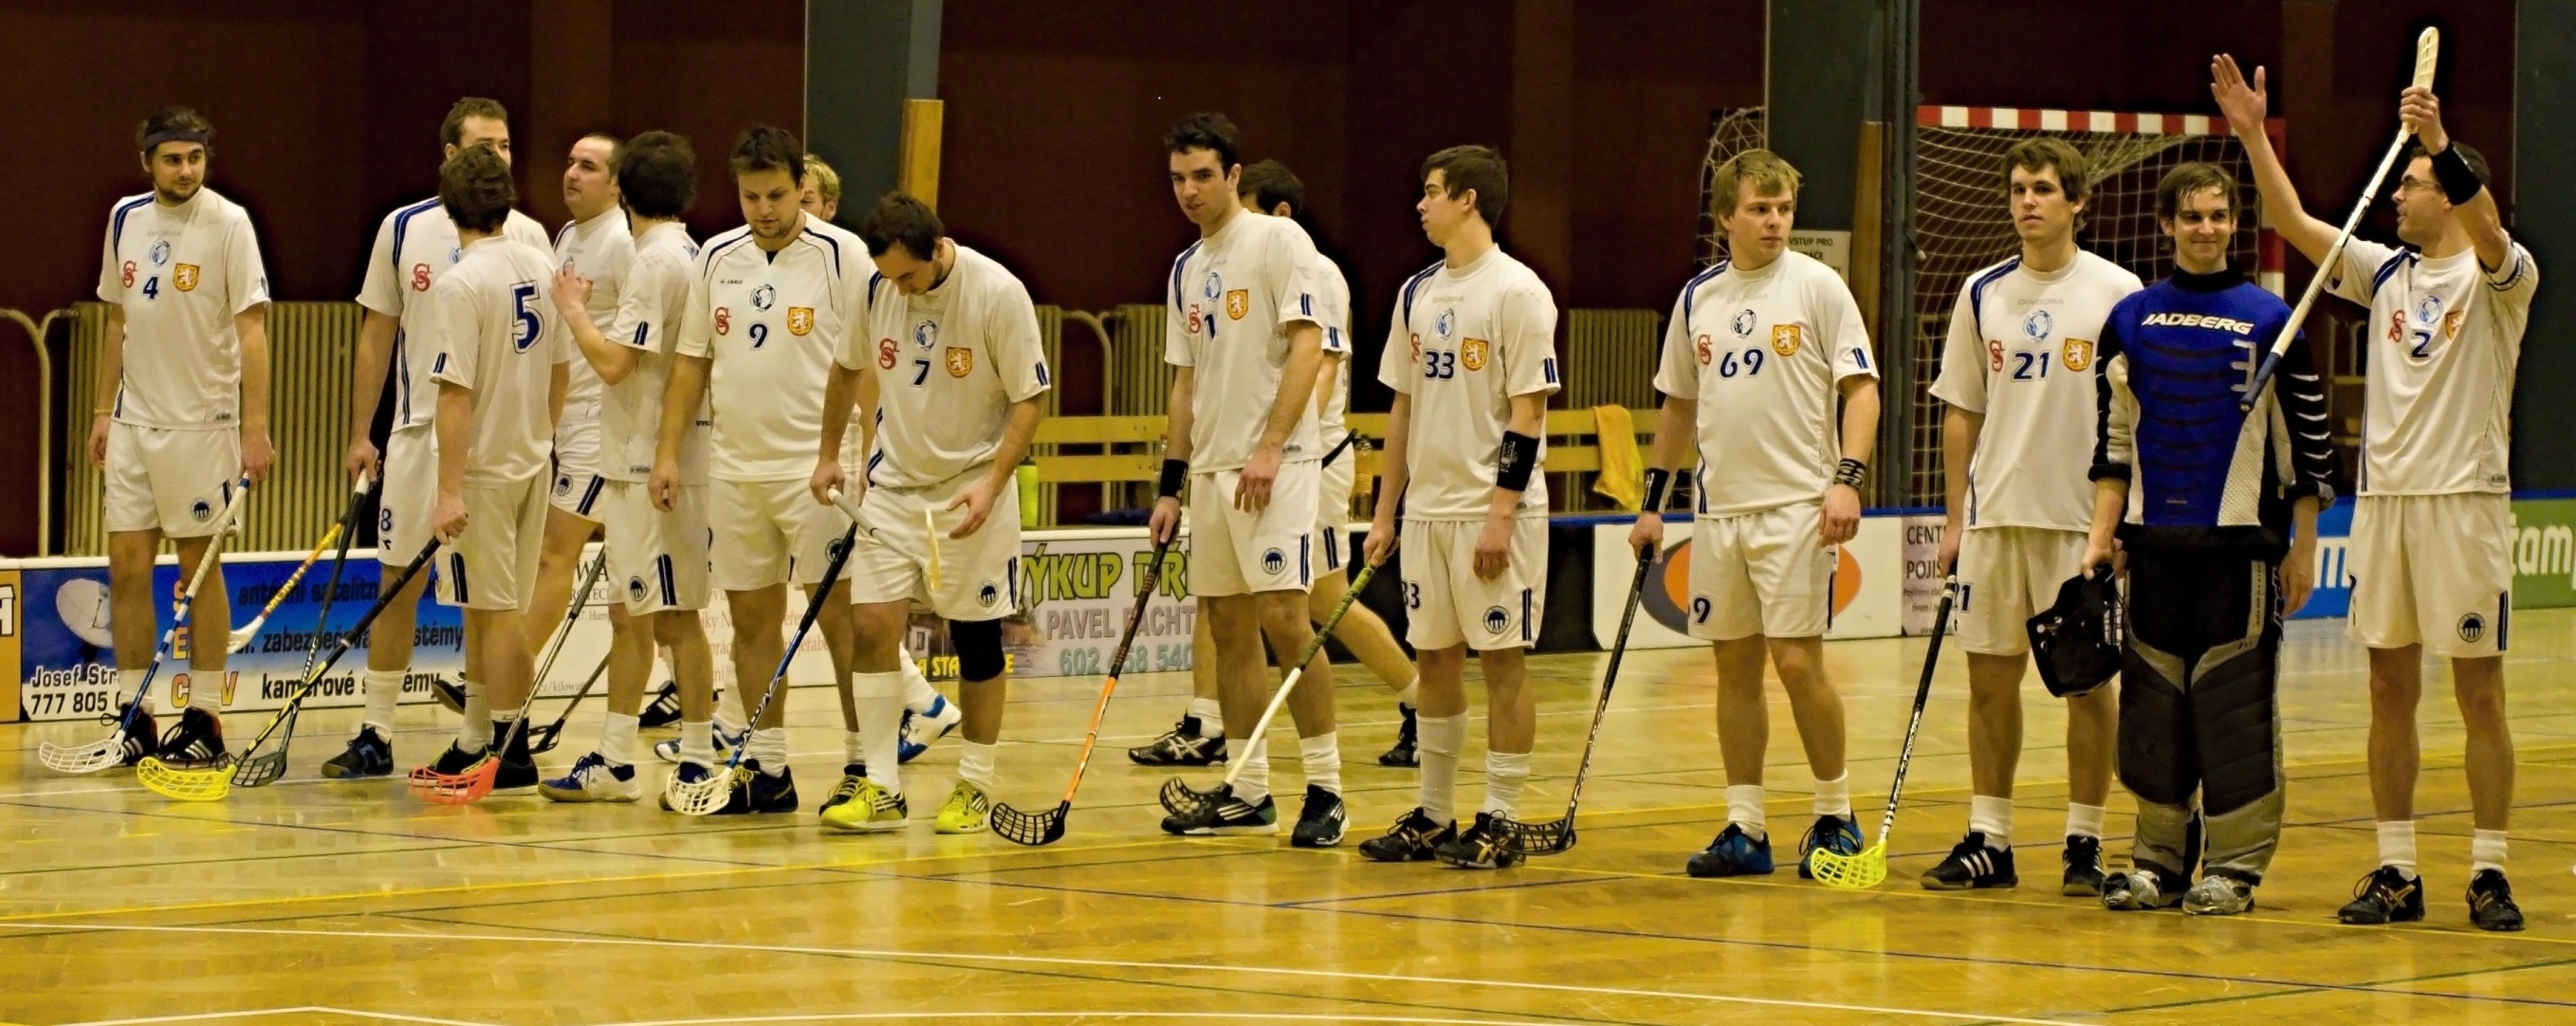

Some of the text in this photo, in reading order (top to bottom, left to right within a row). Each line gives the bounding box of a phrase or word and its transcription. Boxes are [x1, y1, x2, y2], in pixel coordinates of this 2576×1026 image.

[1816, 237, 1833, 247] PRO
[141, 275, 159, 302] 4
[509, 280, 545, 355] 5
[1204, 311, 1219, 341] 1
[2141, 313, 2254, 336] JADBERG
[747, 321, 770, 351] 9
[2410, 328, 2433, 360] 2
[911, 357, 931, 388] 7
[1424, 348, 1456, 381] 33
[1719, 346, 1767, 380] 69
[2011, 349, 2052, 383] 21
[380, 506, 394, 534] 8
[1906, 524, 1947, 546] CENT
[2511, 513, 2576, 590] tam
[1046, 608, 1116, 642] PAVEL
[1693, 595, 1713, 627] 9
[31, 666, 82, 688] Josef
[86, 664, 120, 686] Str
[1058, 646, 1101, 677] 602
[30, 692, 65, 715] 777
[72, 691, 108, 713] 805
